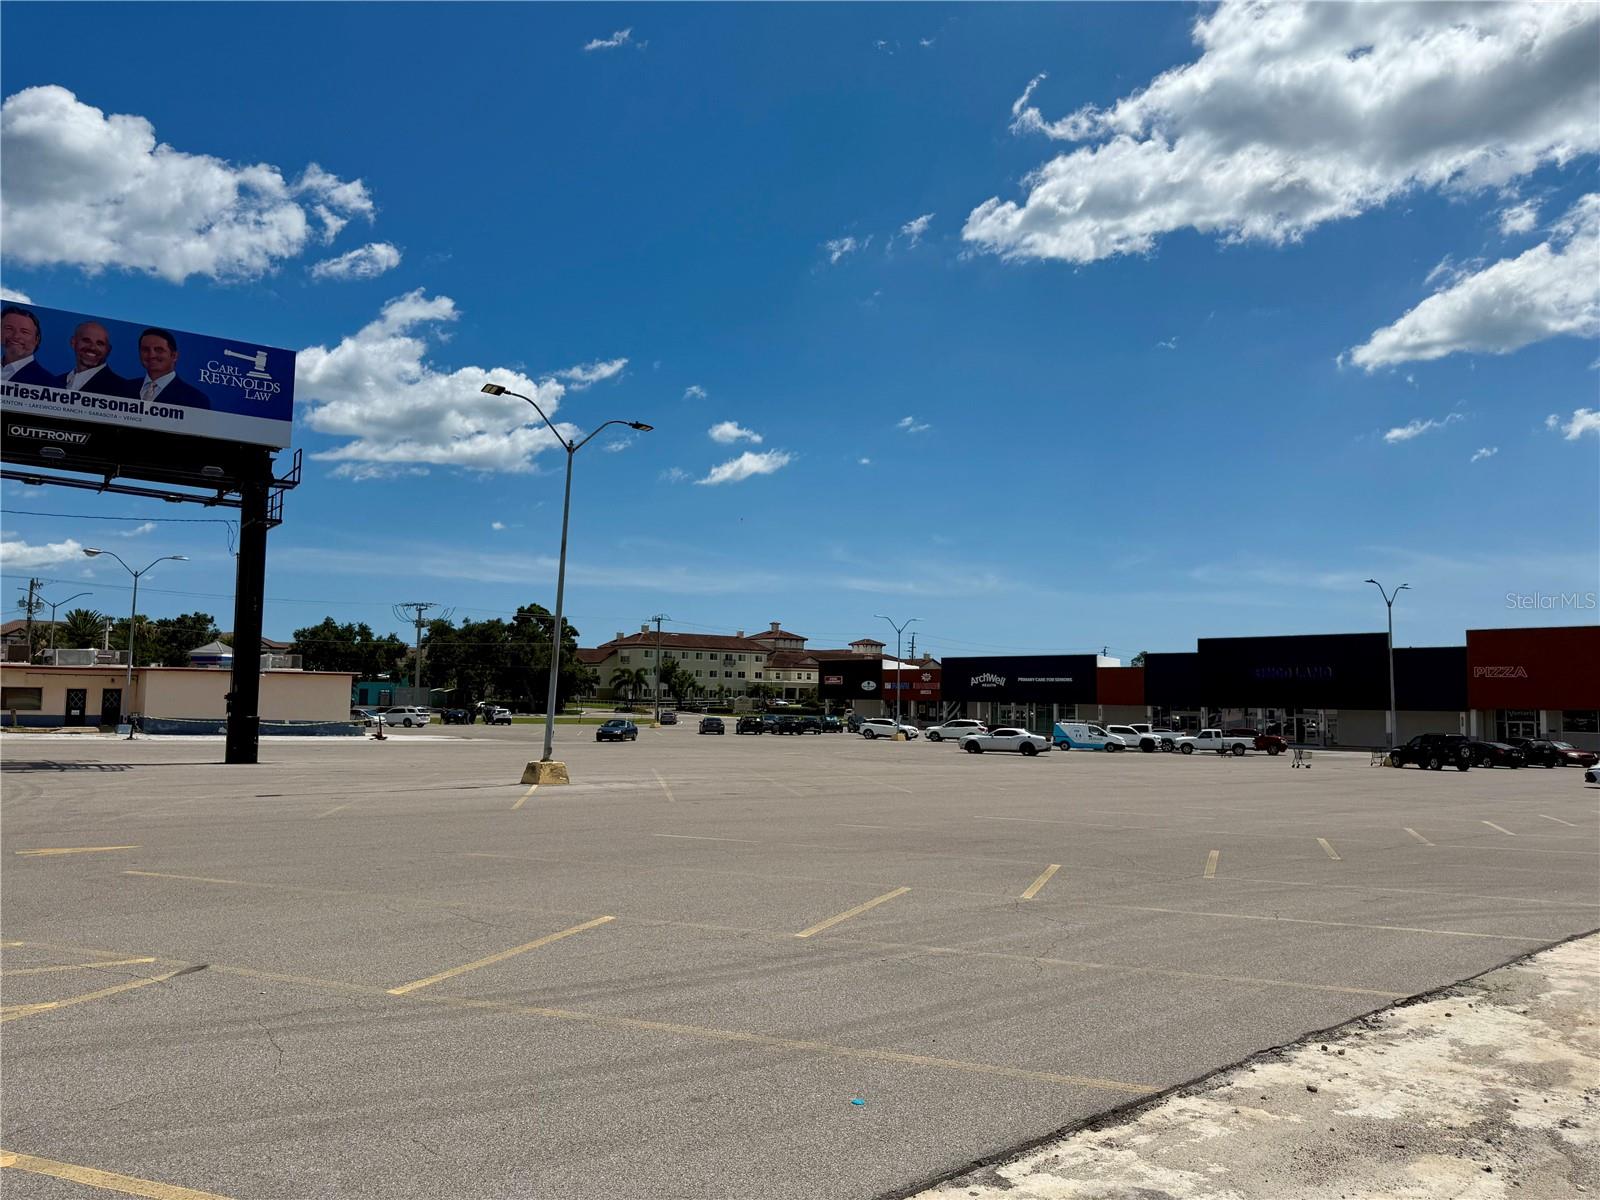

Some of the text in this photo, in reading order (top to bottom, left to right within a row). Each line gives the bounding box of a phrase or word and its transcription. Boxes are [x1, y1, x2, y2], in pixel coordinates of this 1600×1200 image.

[207, 360, 242, 376] CARL
[200, 369, 281, 393] REYNOLDS
[244, 388, 272, 401] LAW
[29, 403, 62, 412] LAKEWOOD
[62, 406, 83, 415] RANCH
[88, 410, 118, 419] SARASOTA
[1473, 665, 1528, 678] PIZZA
[970, 672, 1006, 687] ArchWell
